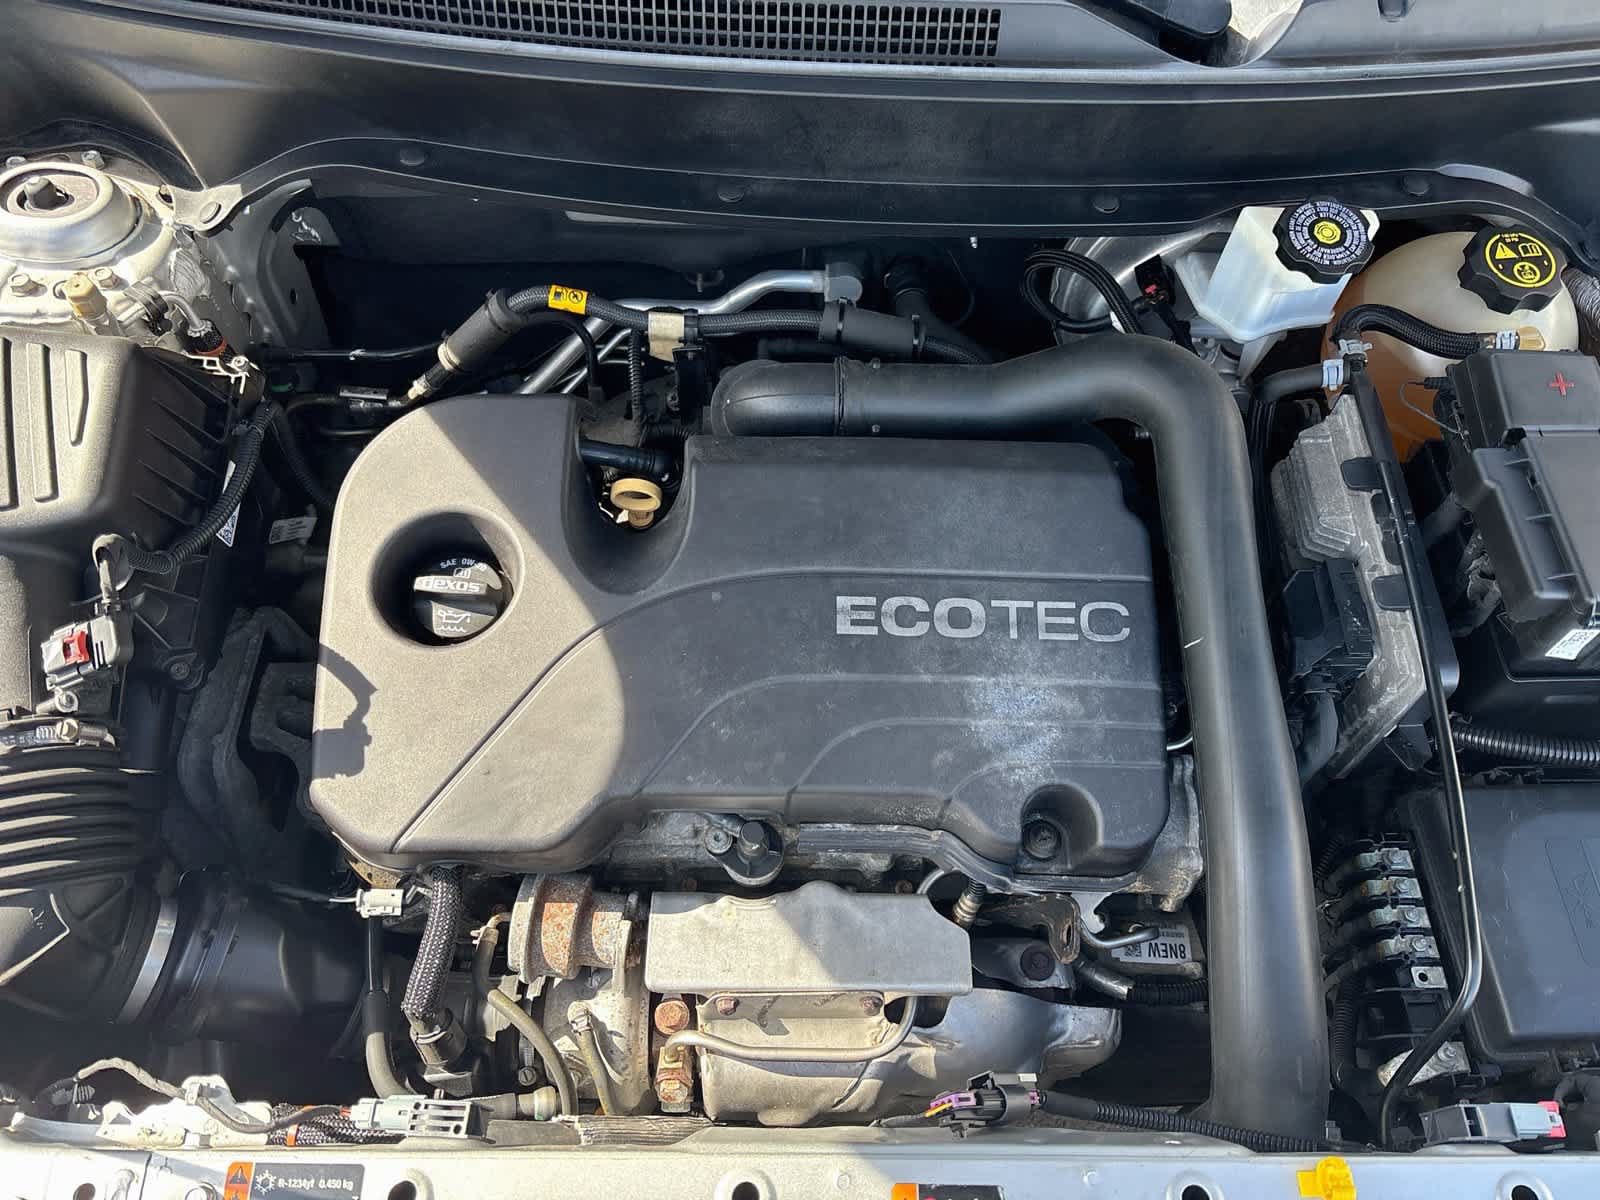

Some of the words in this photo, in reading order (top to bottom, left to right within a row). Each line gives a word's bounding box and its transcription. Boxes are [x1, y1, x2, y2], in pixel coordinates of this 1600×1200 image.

[440, 558, 457, 569] SAE
[836, 596, 1131, 642] ECOTEC
[1148, 942, 1187, 959] 8NEW
